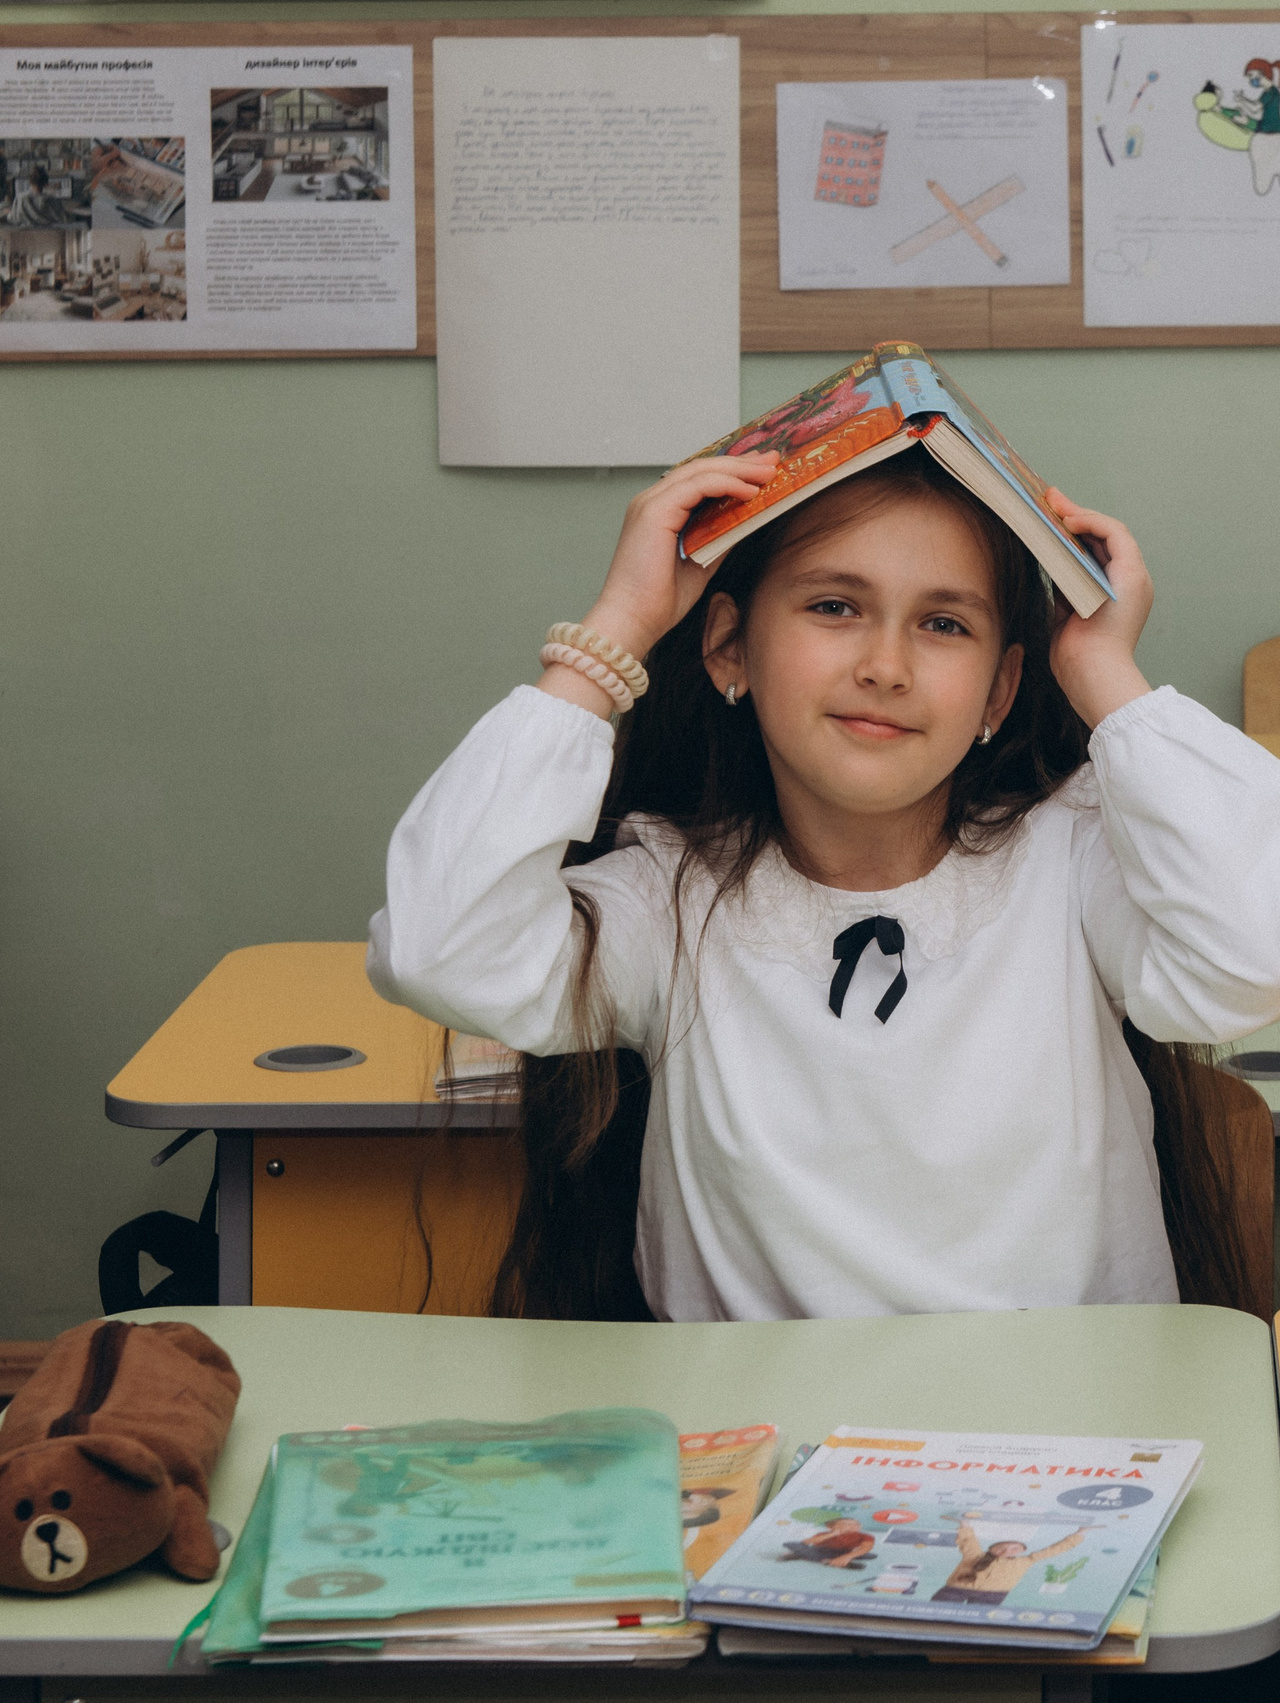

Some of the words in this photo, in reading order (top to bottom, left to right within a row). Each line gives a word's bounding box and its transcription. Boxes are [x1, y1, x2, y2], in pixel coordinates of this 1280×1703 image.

[16, 59, 41, 71] Моя
[44, 58, 99, 72] майбутня
[101, 58, 153, 72] професія
[244, 57, 300, 70] дизайнер
[850, 1456, 1145, 1479] ІНФОРМАТИКА
[1095, 1487, 1123, 1500] 4
